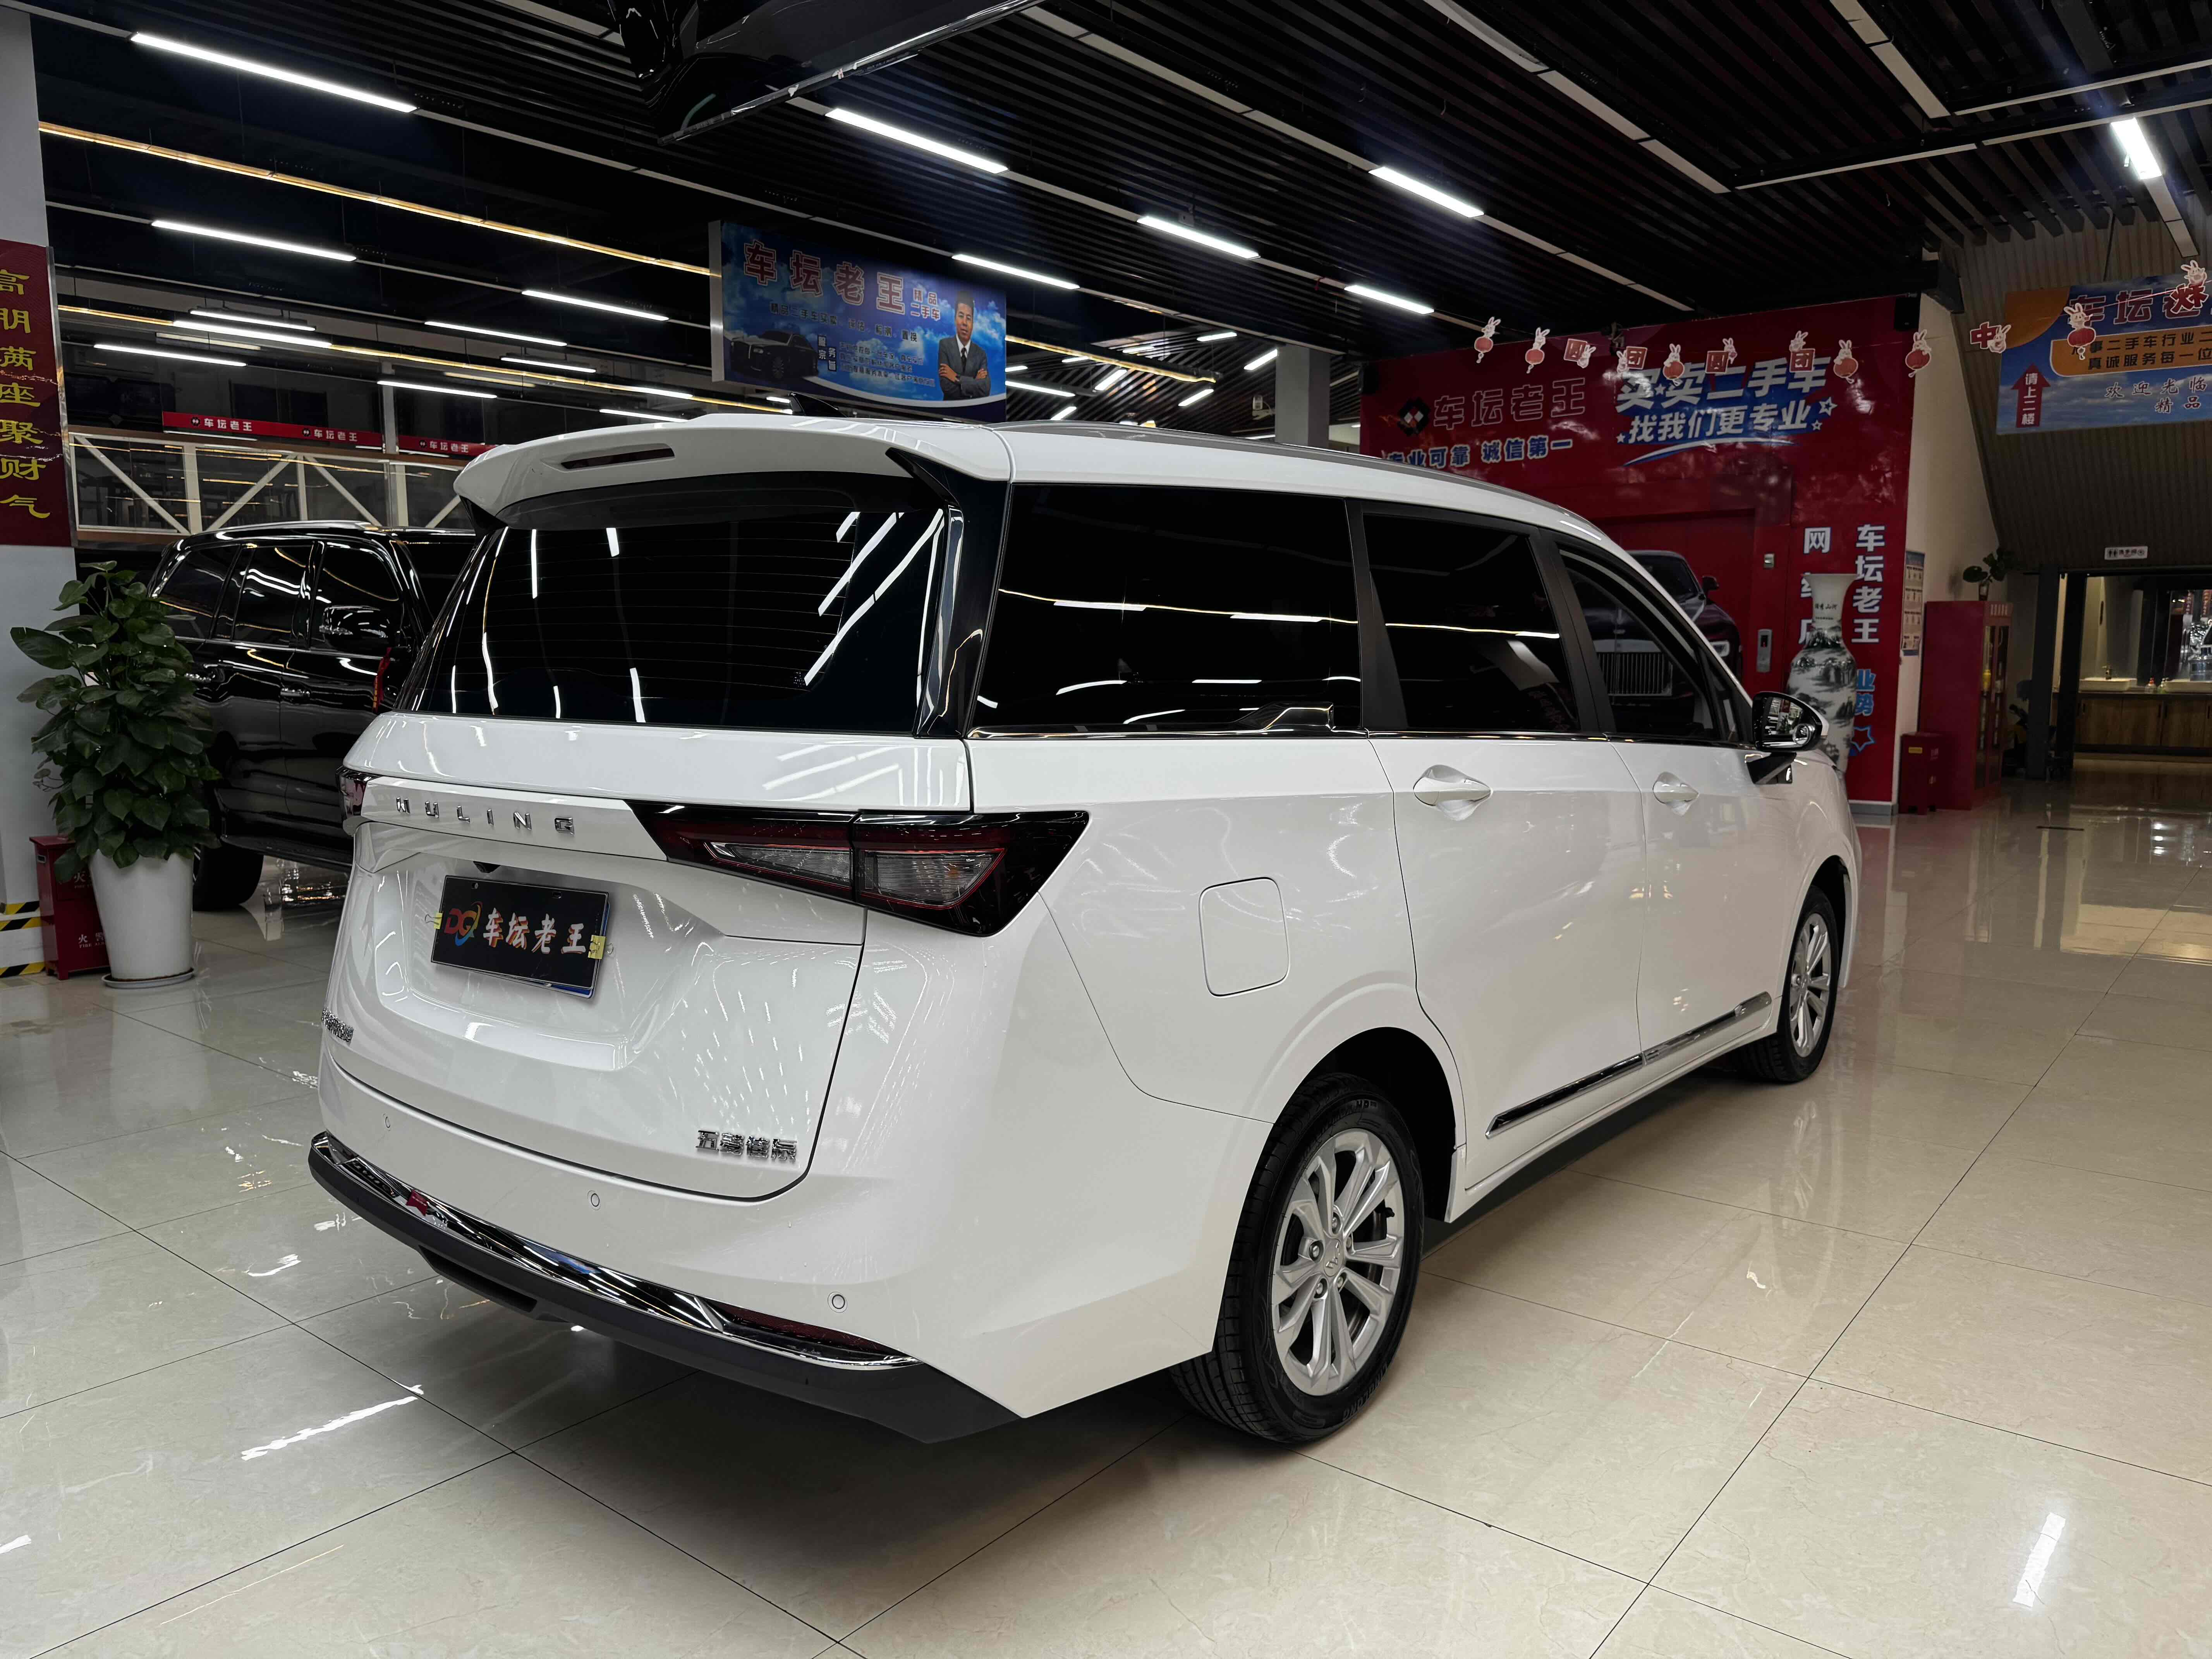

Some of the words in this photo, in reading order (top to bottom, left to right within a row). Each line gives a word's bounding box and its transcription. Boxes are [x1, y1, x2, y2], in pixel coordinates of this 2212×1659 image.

[744, 239, 905, 315] 车坛老王
[912, 288, 938, 306] 精品
[910, 304, 941, 321] 二手车
[2088, 348, 2212, 370] 真诚服务每一位
[1616, 357, 1831, 413] 买卖二手车
[2021, 372, 2038, 426] 请上二楼
[2105, 376, 2207, 399] 欢迎光临
[1434, 378, 1585, 430] 车坛老王
[2154, 396, 2202, 414] 精品
[204, 418, 252, 432] 车坛老王
[314, 429, 357, 442] 车坛老王
[1628, 399, 1812, 444] 找我们更专业
[429, 441, 469, 453] 车坛老王
[1482, 435, 1573, 463] 诚信第一
[1851, 524, 1885, 643] 车坛老王
[396, 797, 575, 836] WULING
[483, 907, 587, 955] 车坛老王
